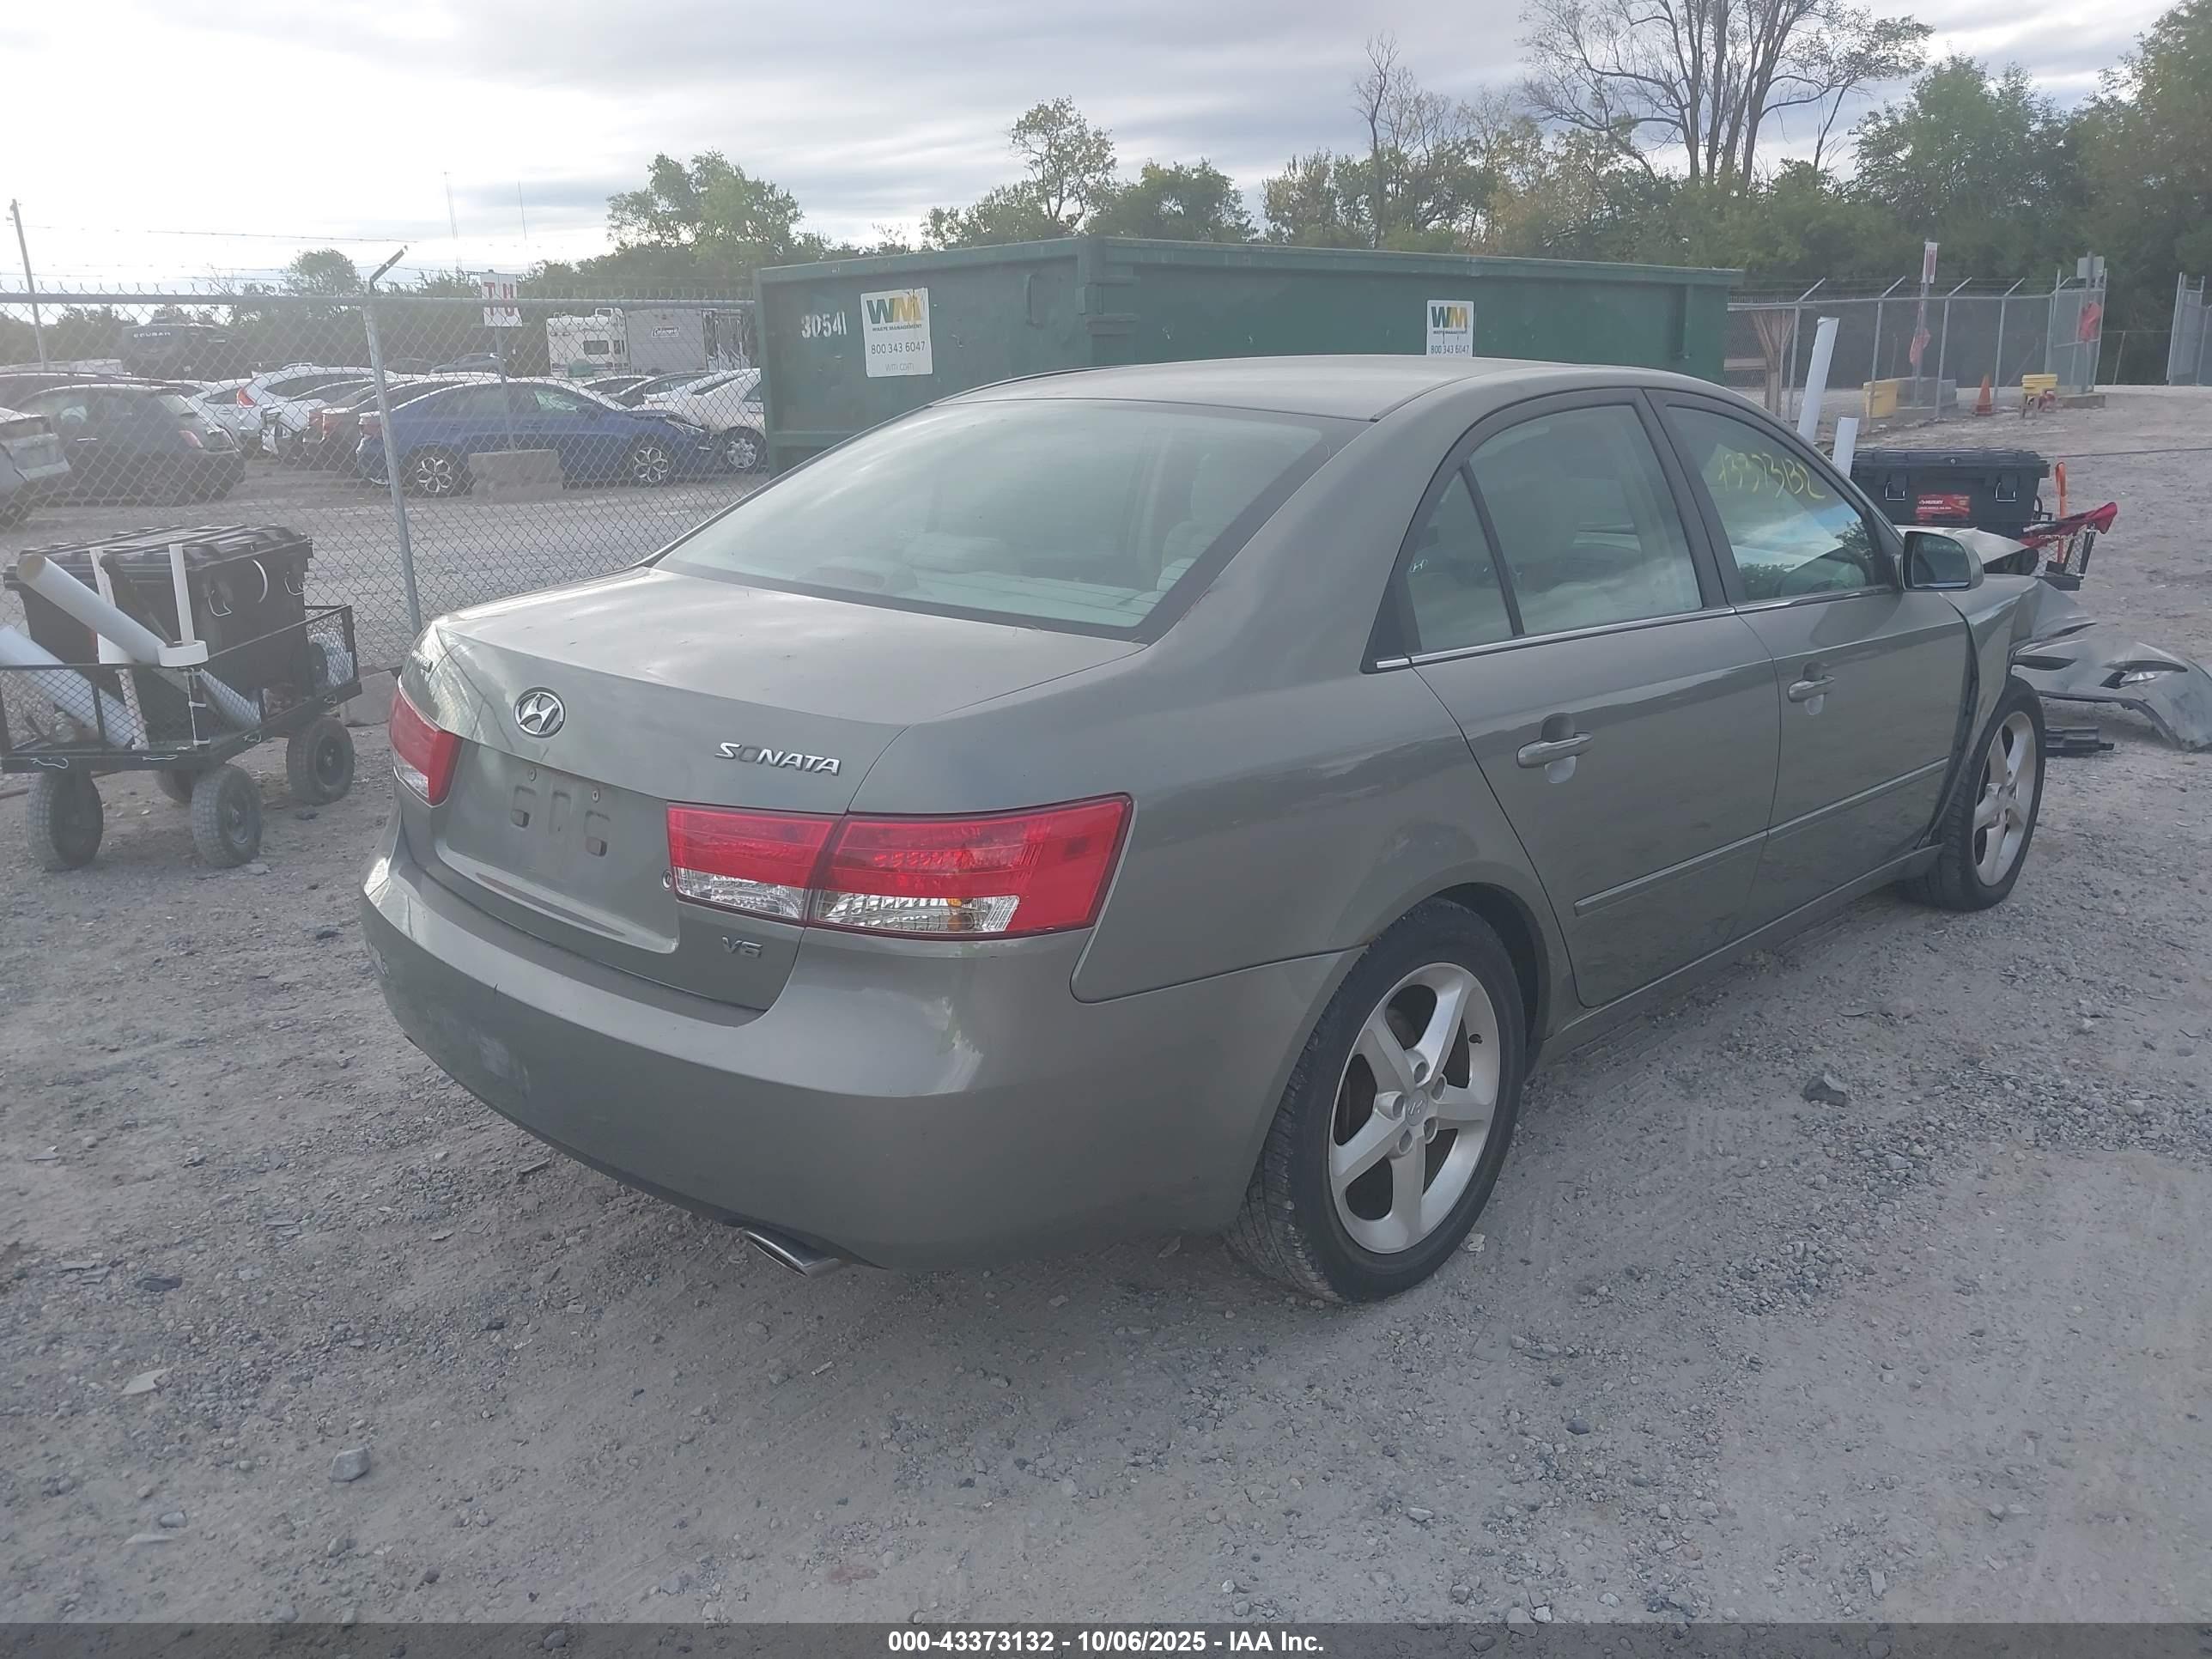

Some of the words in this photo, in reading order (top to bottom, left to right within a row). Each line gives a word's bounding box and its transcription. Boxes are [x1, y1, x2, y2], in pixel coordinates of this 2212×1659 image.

[800, 311, 848, 338] 30541
[1431, 306, 1468, 328] WM
[871, 343, 886, 355] 800
[888, 343, 902, 354] 343
[905, 340, 926, 353] 6047
[1443, 344, 1454, 354] 343
[714, 742, 840, 775] SONATA
[722, 936, 763, 957] V6
